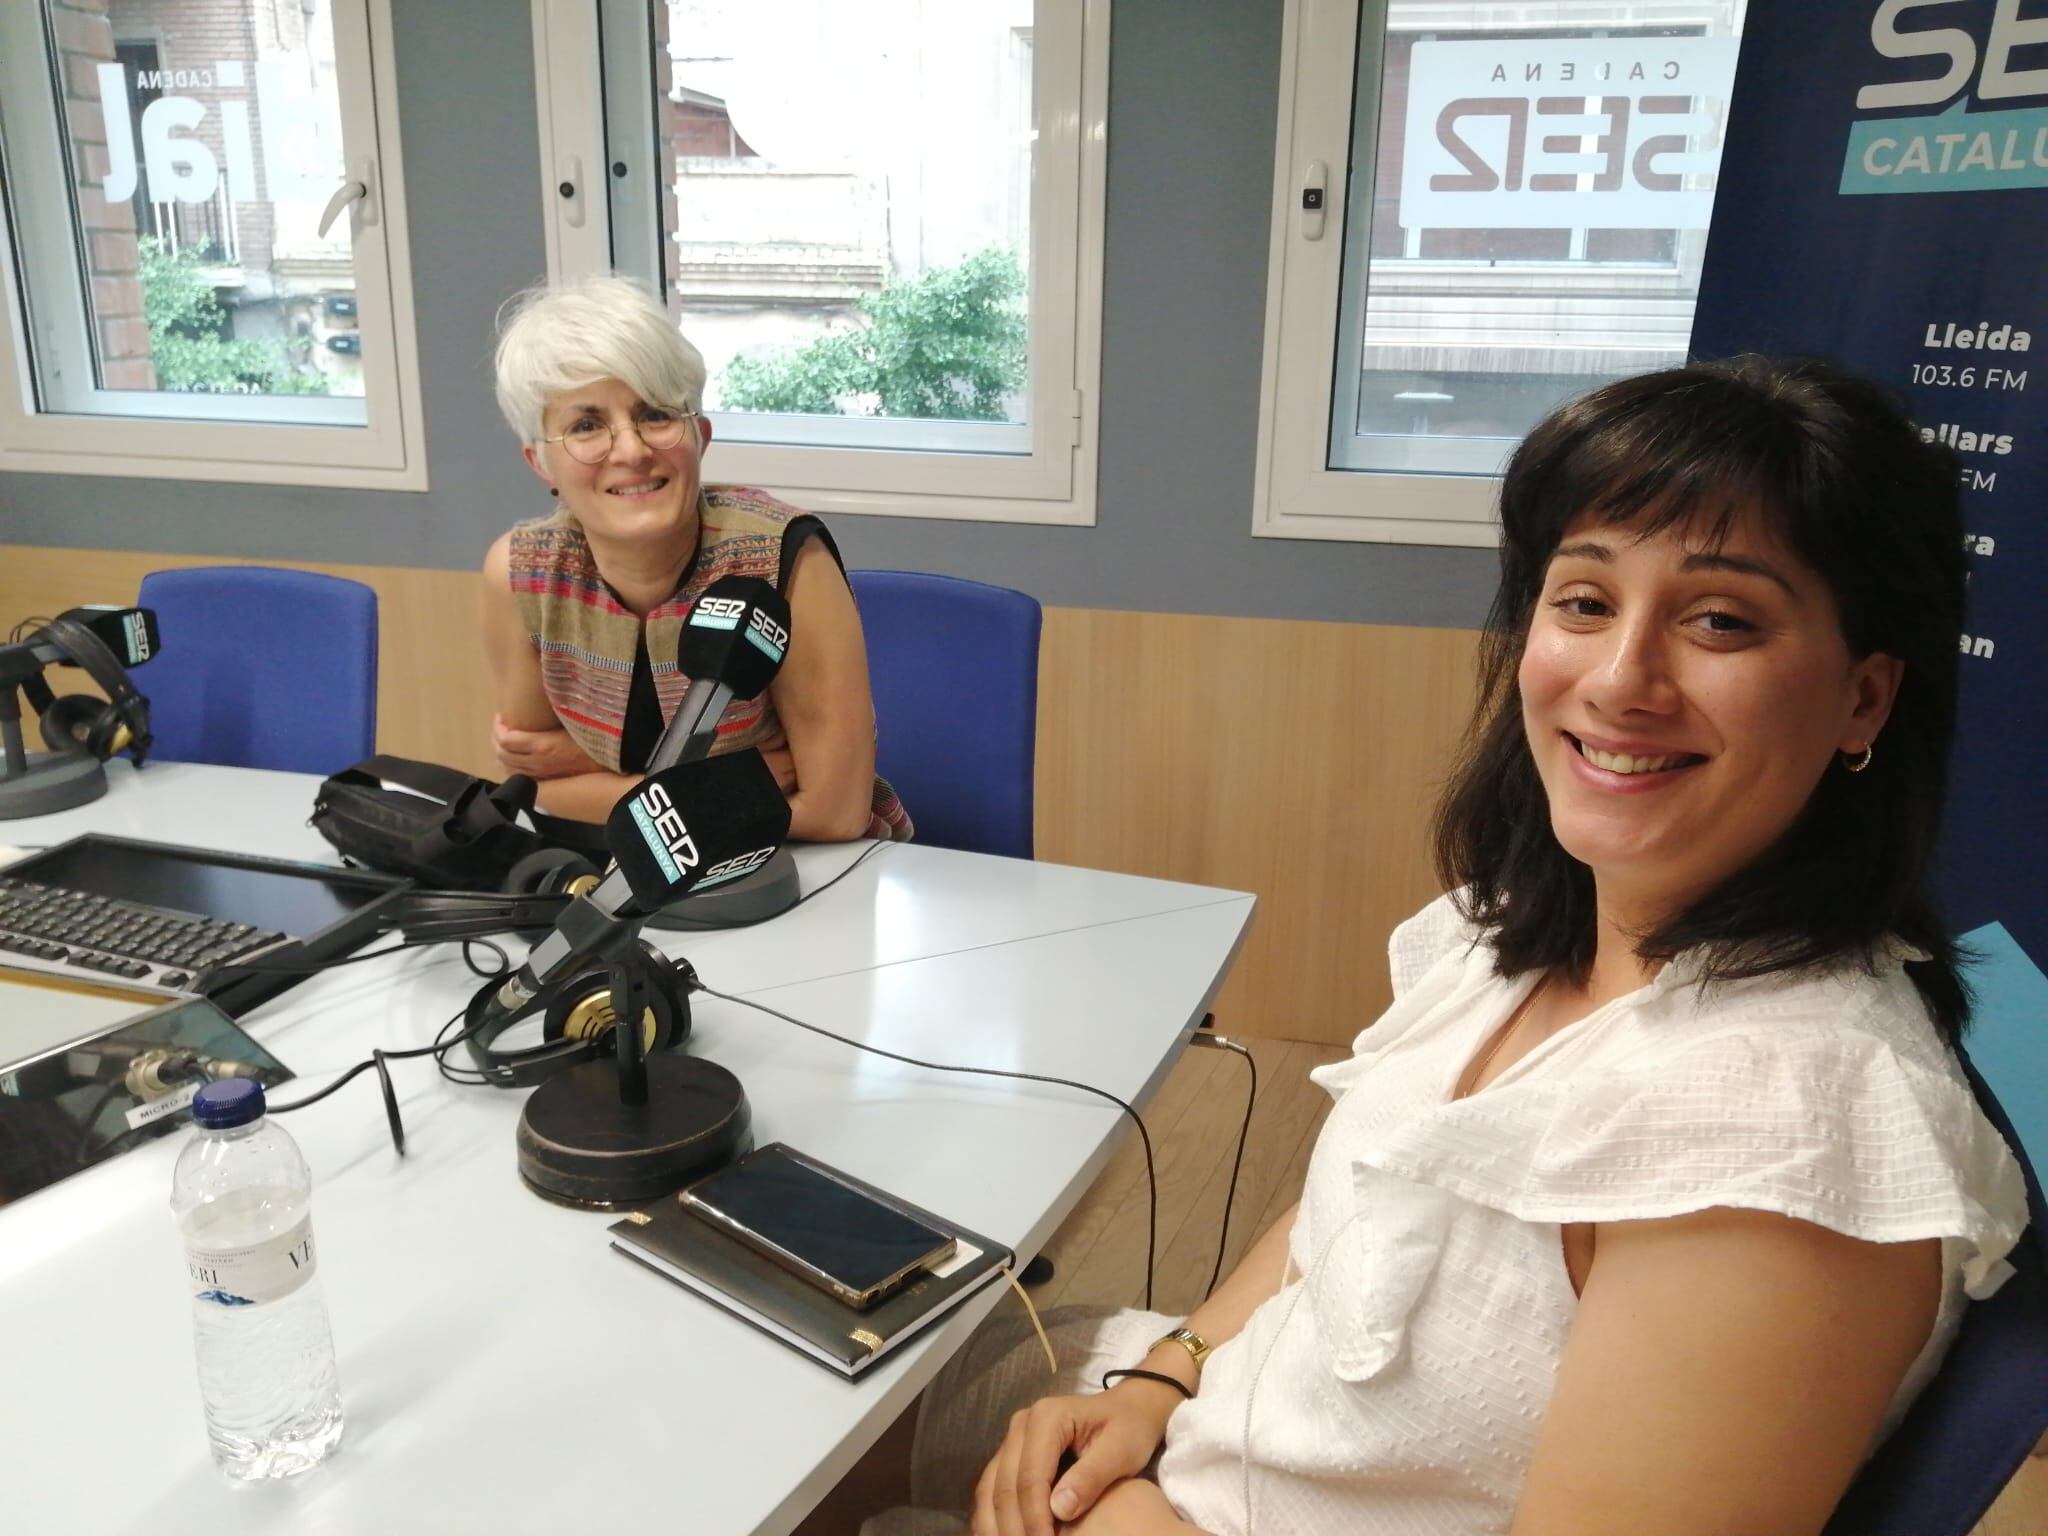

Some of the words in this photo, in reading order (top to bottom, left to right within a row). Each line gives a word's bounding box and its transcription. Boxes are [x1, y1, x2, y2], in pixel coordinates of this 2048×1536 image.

[1923, 321, 2032, 352] Lleida
[1911, 364, 1976, 388] 103.6
[1984, 368, 2028, 392] FM
[1909, 421, 2015, 456] allars
[694, 597, 747, 619] SER
[130, 611, 150, 663] SER
[749, 607, 788, 652] SER
[632, 803, 675, 878] CATALUNYA
[639, 782, 699, 876] SER
[698, 846, 776, 883] SER
